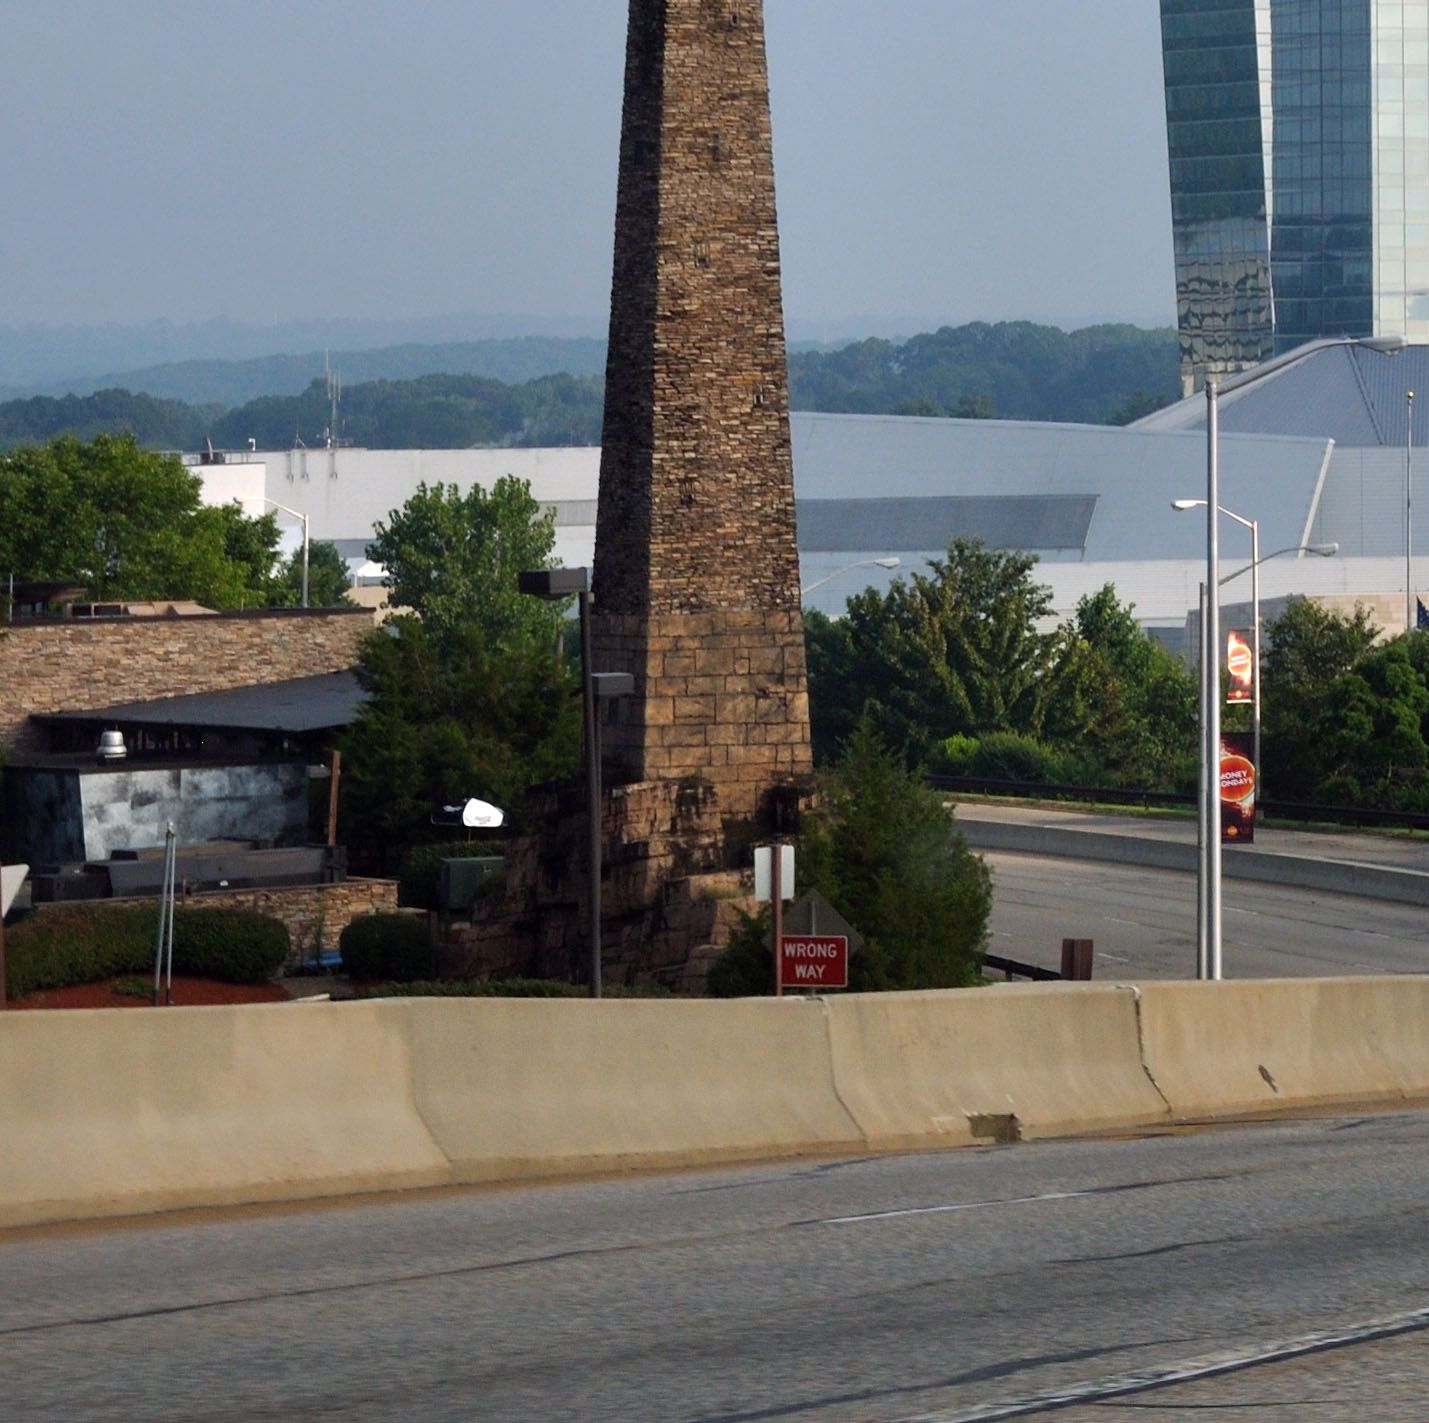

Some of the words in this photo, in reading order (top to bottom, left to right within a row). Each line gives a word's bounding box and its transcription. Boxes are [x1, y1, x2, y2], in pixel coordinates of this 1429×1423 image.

[1220, 777, 1253, 788] ONDAYS
[784, 943, 837, 958] WRONG
[794, 964, 826, 979] WAY
